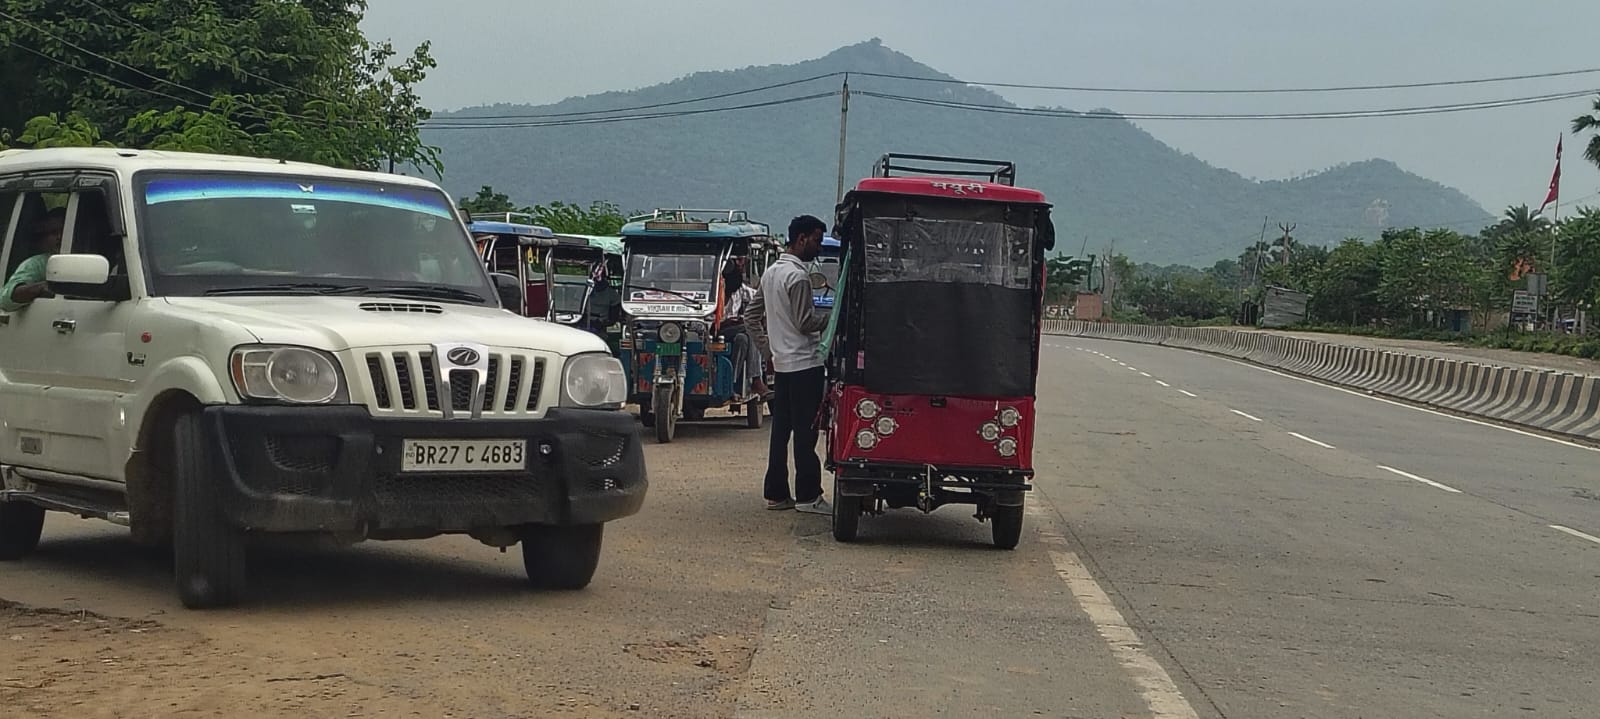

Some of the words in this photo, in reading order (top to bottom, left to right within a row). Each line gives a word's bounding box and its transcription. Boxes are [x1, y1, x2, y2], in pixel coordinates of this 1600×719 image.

[930, 181, 987, 195] मयूरी
[415, 445, 459, 464] BR27
[465, 445, 475, 464] C
[481, 444, 523, 464] 4683
